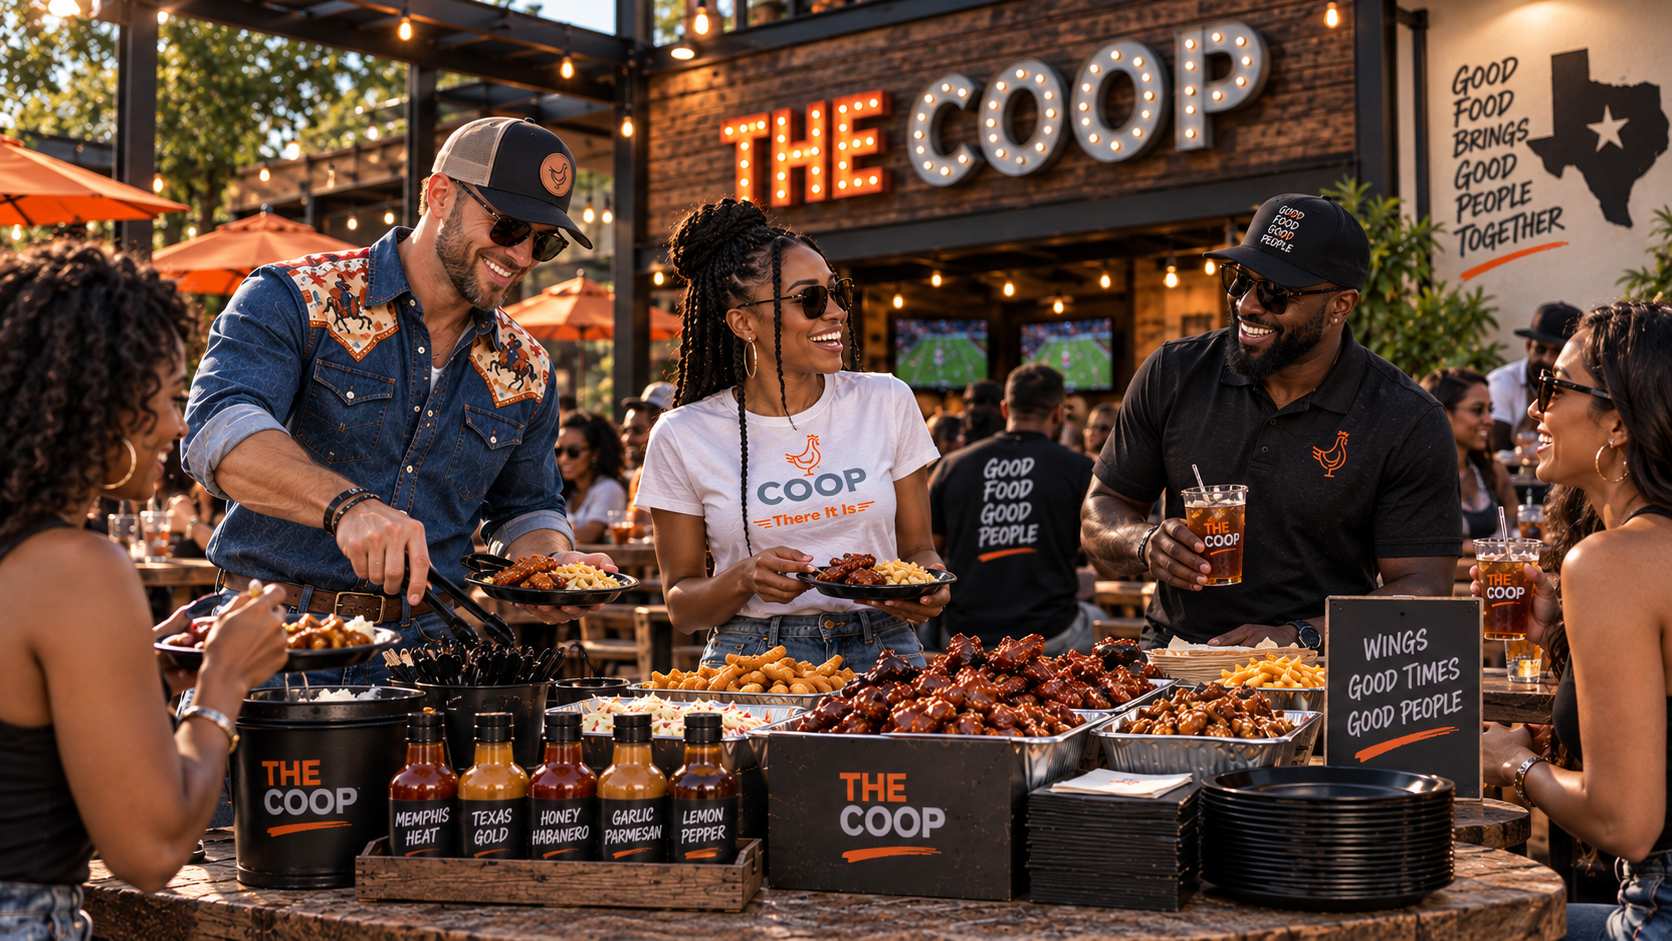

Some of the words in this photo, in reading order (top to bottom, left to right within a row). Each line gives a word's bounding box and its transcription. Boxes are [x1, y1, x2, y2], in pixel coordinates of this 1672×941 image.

[1452, 56, 1518, 95] GOOD
[720, 89, 892, 207] THE
[907, 20, 1270, 187] COOP
[1453, 90, 1514, 128] FOOD
[1453, 117, 1529, 158] BRINGS
[1454, 153, 1517, 191] GOOD
[1455, 180, 1533, 224] PEOPLE
[1268, 224, 1294, 240] GOOD
[1272, 214, 1299, 230] FOOD
[1453, 206, 1565, 258] TOGETHER
[1260, 234, 1294, 253] PEOPLE
[983, 457, 1035, 479] GOOD
[757, 467, 867, 506] COOP
[983, 479, 1034, 502] FOOD
[772, 512, 821, 527] There
[824, 506, 838, 518] It
[841, 503, 857, 515] Is
[980, 502, 1032, 526] GOOD
[978, 523, 1039, 548] PEOPLE
[1203, 521, 1230, 535] THE
[1204, 532, 1240, 548] COOP
[1486, 573, 1512, 586] THE
[1486, 586, 1525, 599] COOP
[1363, 628, 1428, 661] WINGS
[1348, 669, 1398, 701] GOOD
[1402, 657, 1460, 690] TIMES
[1347, 705, 1395, 738] GOOD
[1400, 689, 1463, 725] PEOPLE
[261, 759, 322, 787] THE
[839, 772, 907, 803] THE
[263, 787, 359, 816] COOP
[395, 806, 450, 828] MEMPHIS
[471, 808, 513, 827] TEXAS
[540, 807, 582, 826] HONEY
[612, 806, 655, 826] GARLIC
[682, 806, 725, 825] LEMON
[839, 804, 946, 839] COOP
[405, 826, 441, 847] HEAT
[473, 827, 509, 847] GOLD
[532, 825, 590, 846] HABANERO
[604, 824, 663, 846] PARMESAN
[681, 824, 726, 845] PEPPER
